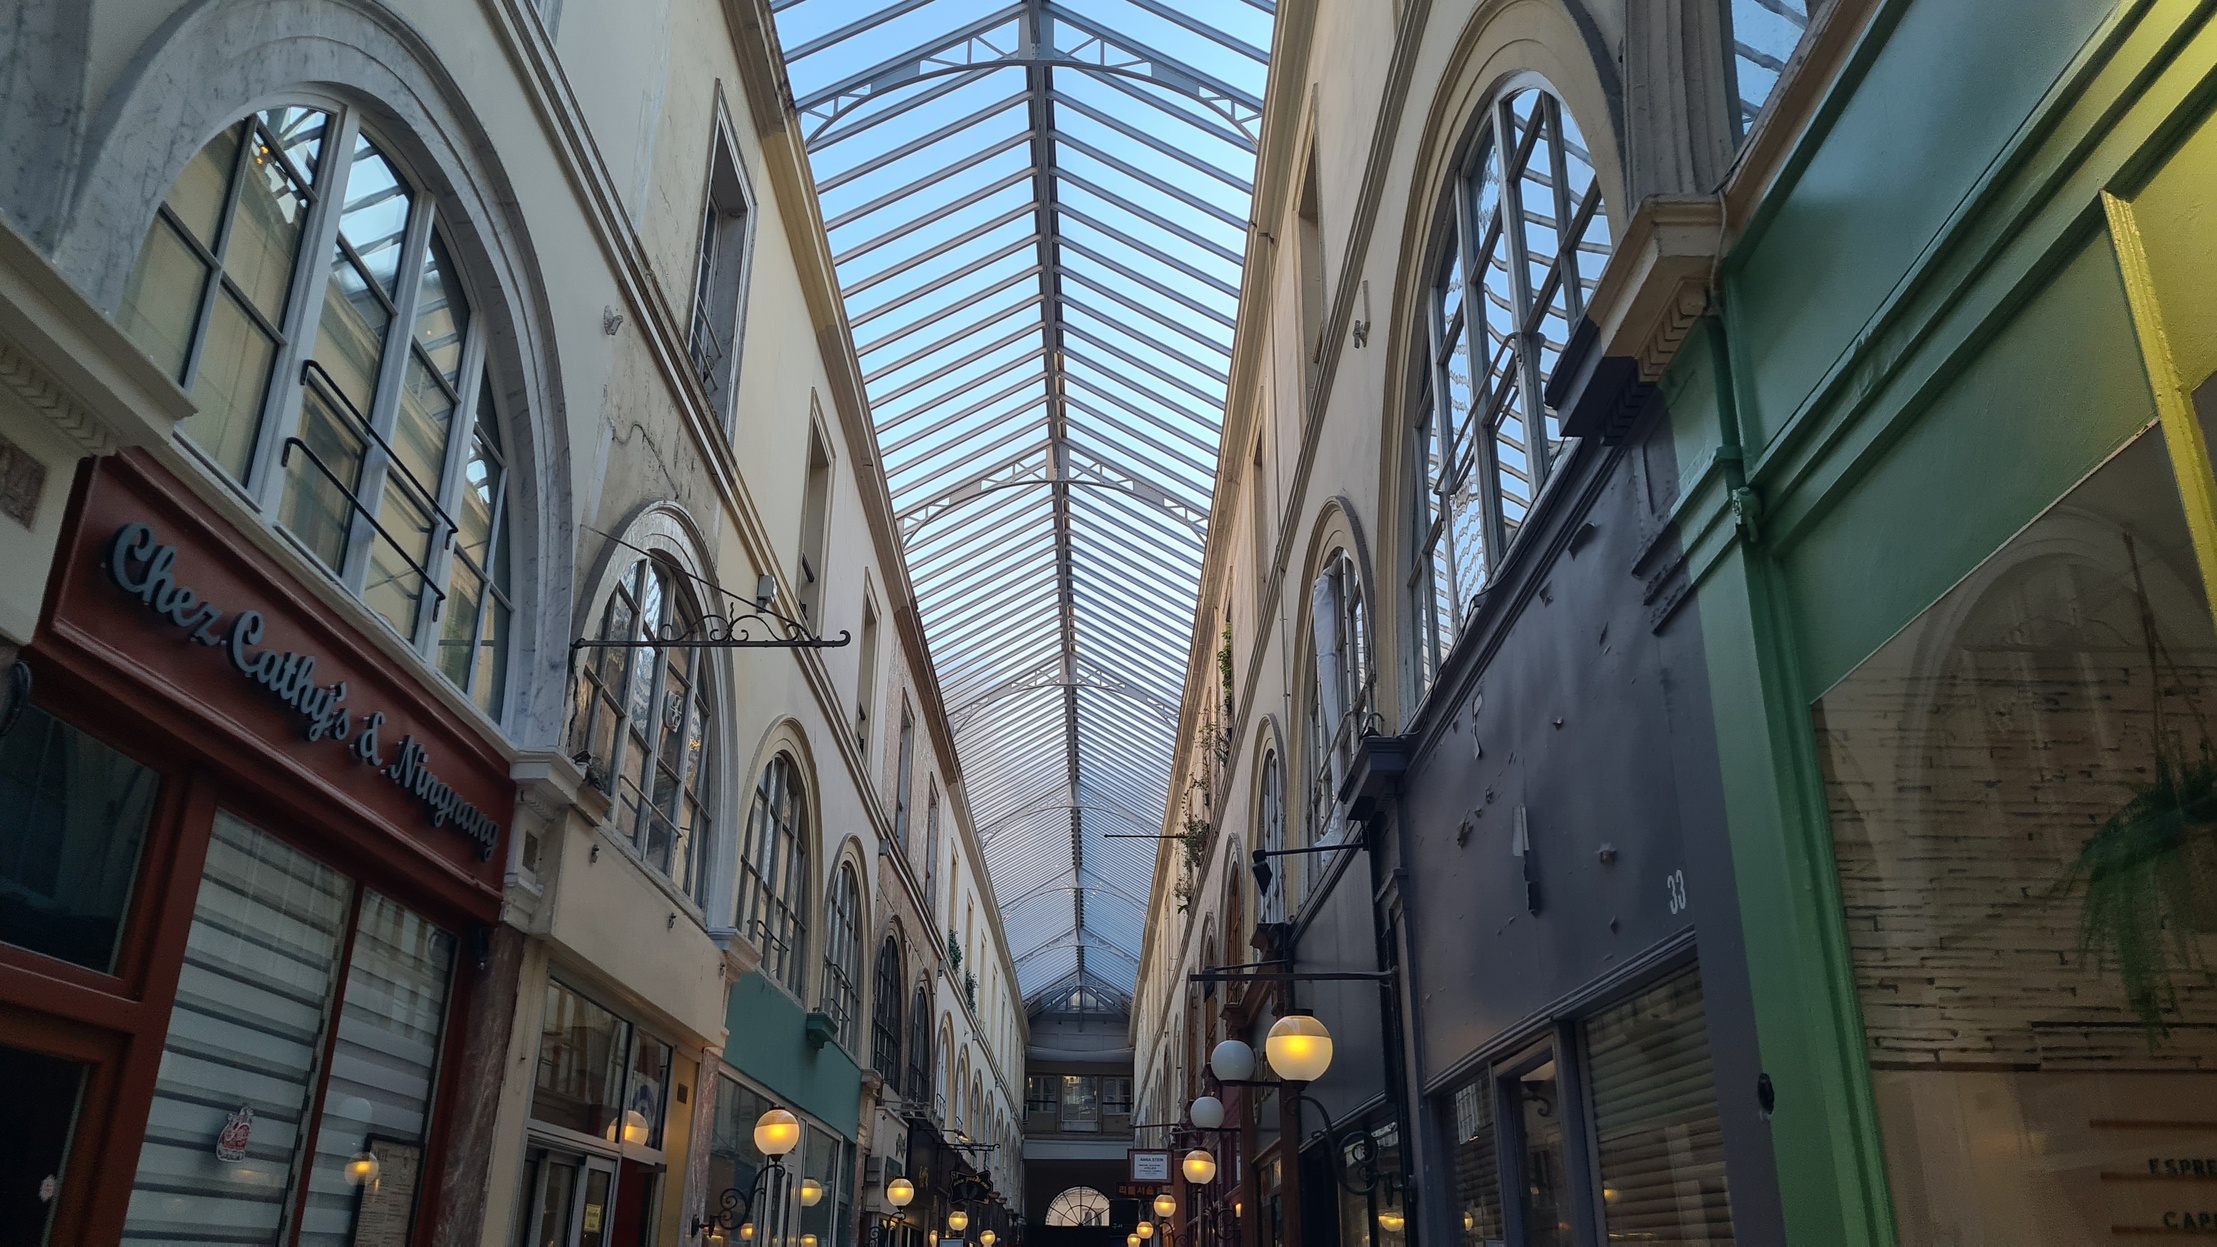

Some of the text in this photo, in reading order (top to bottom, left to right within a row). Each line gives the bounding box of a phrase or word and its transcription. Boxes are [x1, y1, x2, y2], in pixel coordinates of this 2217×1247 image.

[110, 522, 223, 646] Chez
[230, 610, 350, 742] Cathy's
[1667, 869, 1686, 915] 33
[2163, 1211, 2217, 1229] CAP
